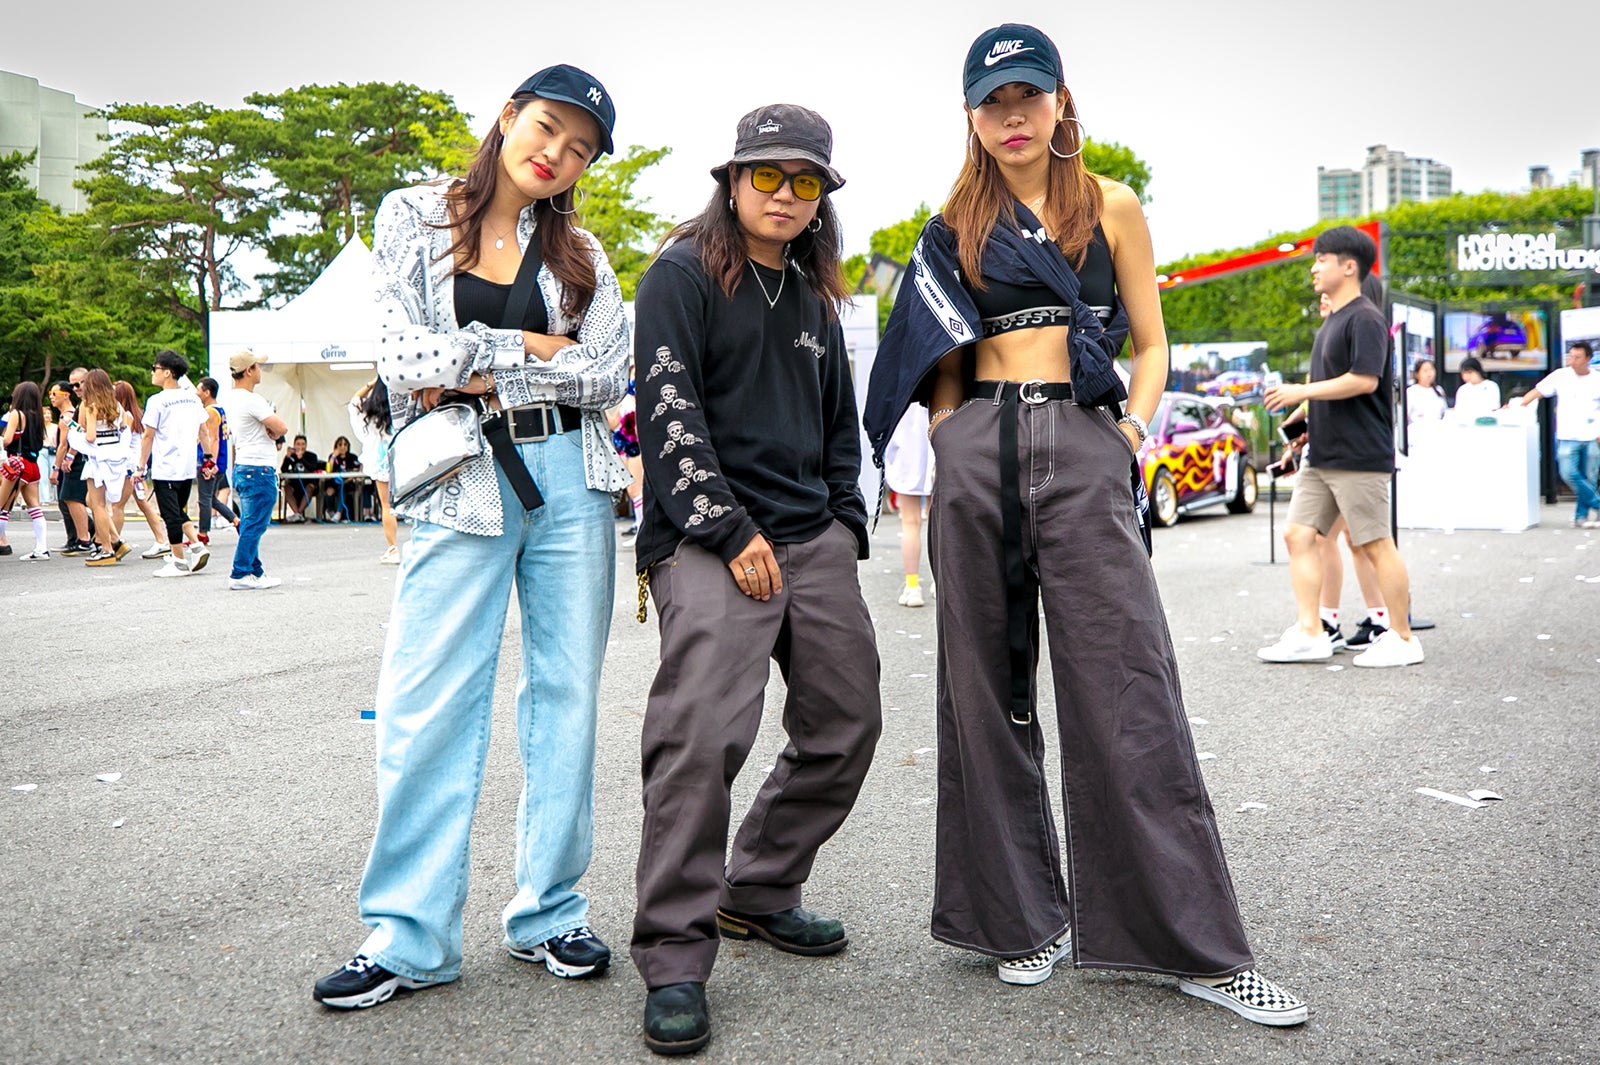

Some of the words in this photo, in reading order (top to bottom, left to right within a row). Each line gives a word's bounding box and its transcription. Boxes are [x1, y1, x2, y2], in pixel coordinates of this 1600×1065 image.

[991, 40, 1024, 55] NIKE
[586, 86, 603, 106] NY
[1457, 233, 1557, 252] HYUNDAI
[924, 282, 945, 309] UMBRO
